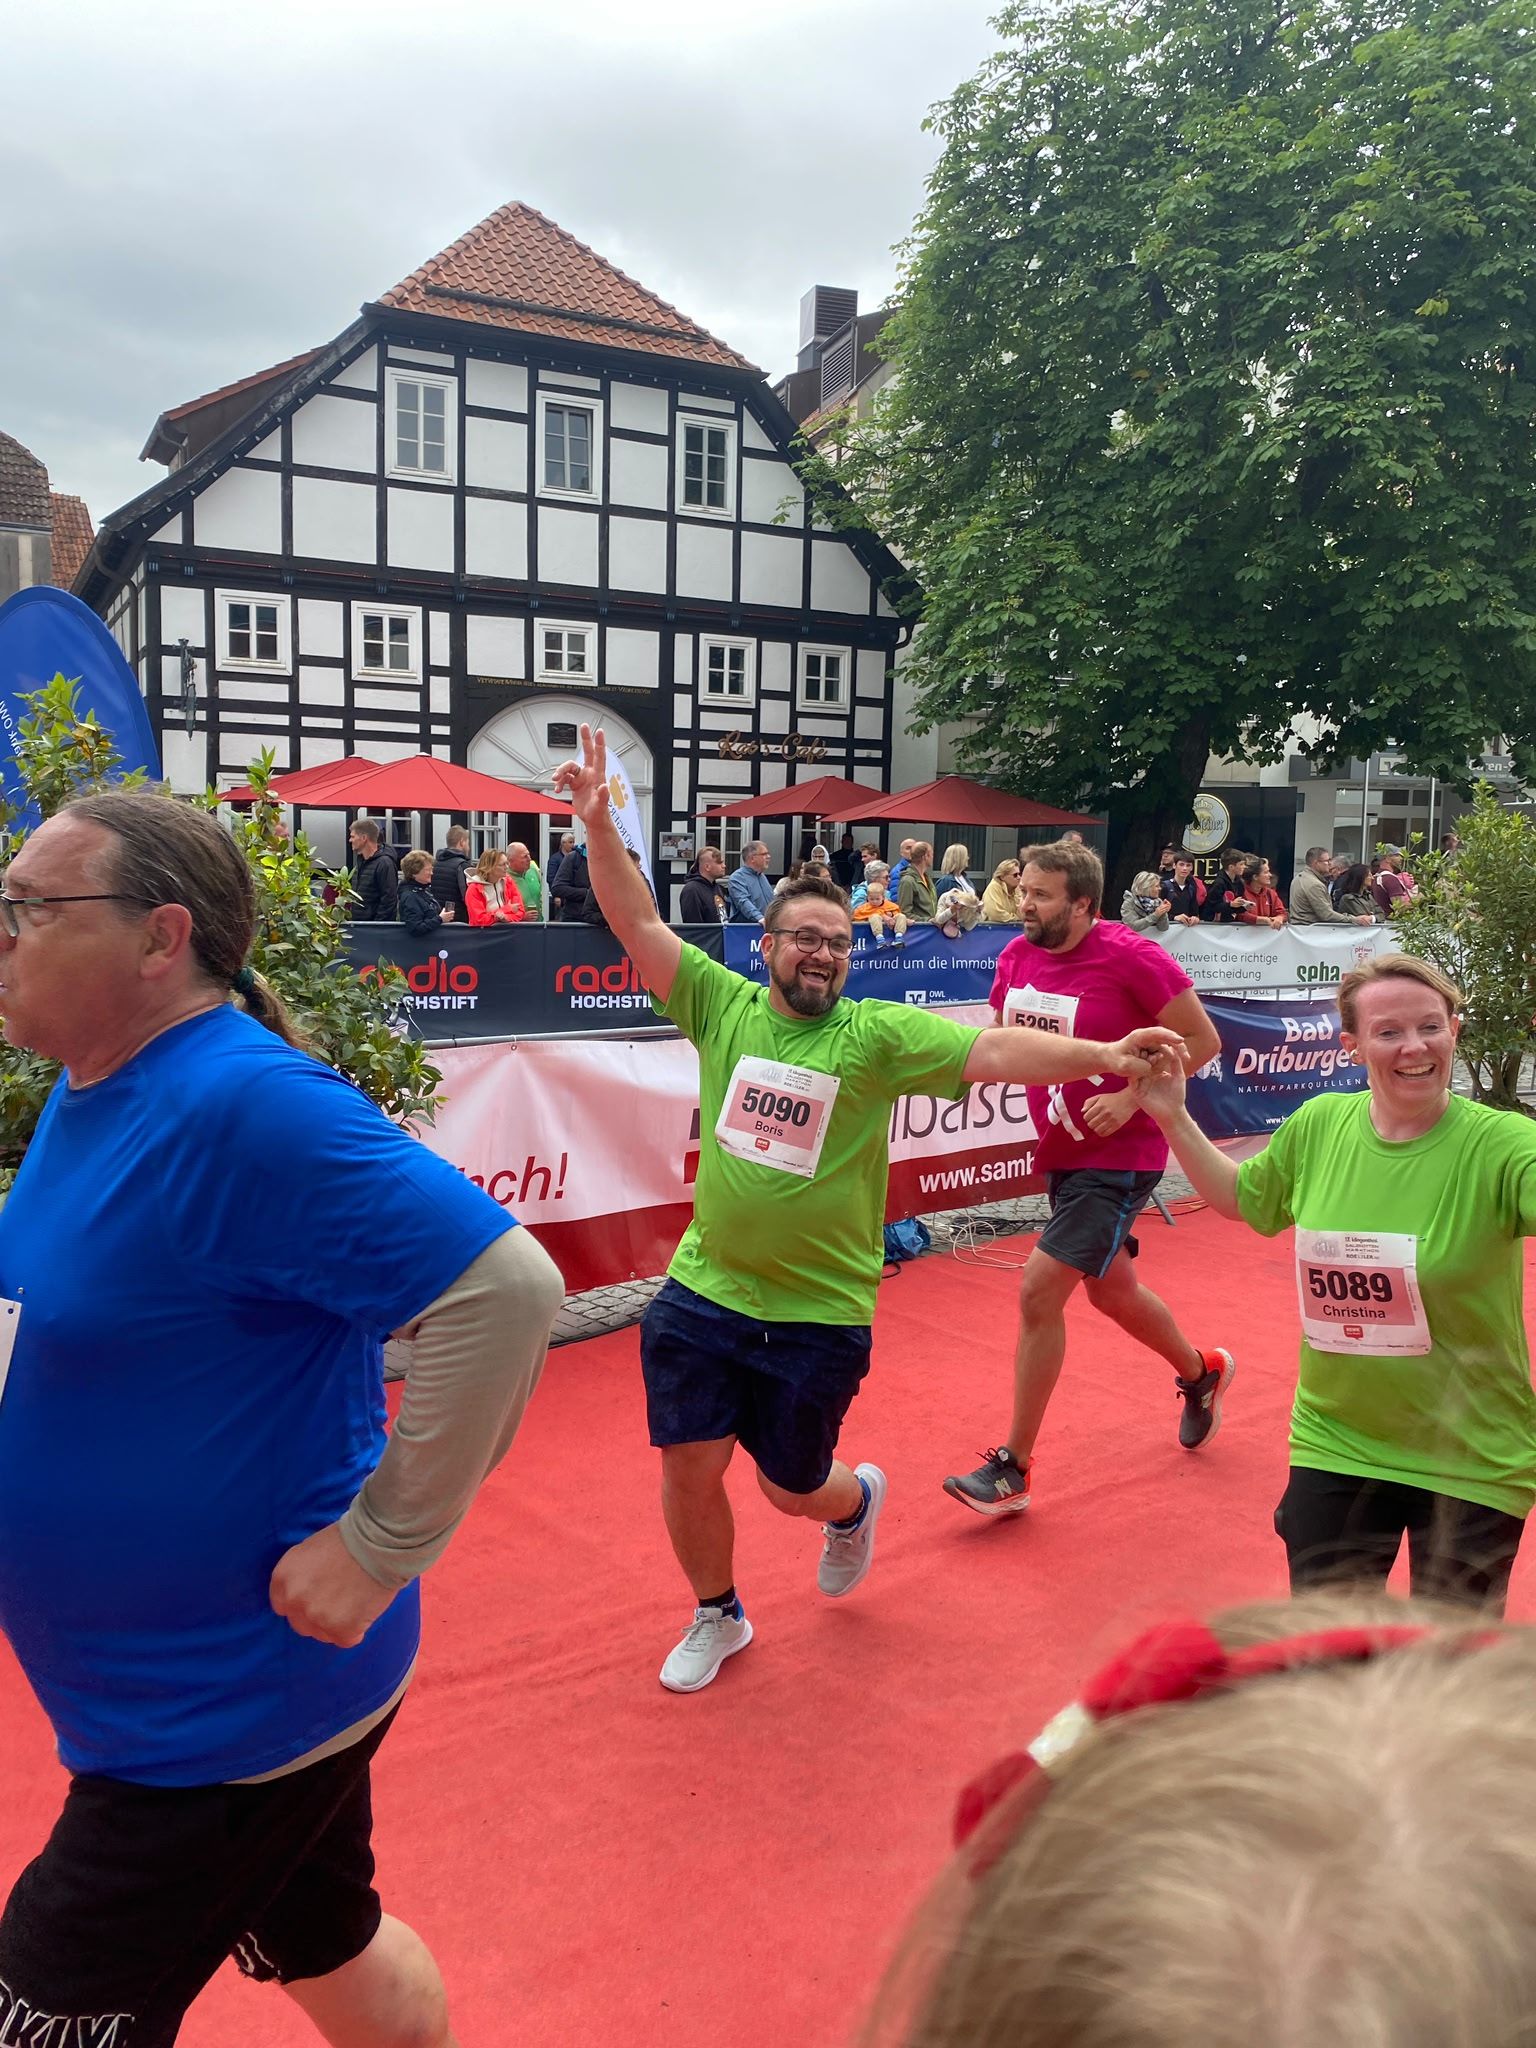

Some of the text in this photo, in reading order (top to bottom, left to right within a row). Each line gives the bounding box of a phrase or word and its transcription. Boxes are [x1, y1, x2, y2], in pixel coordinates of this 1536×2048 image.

[869, 957, 899, 969] rund
[903, 959, 924, 969] um
[928, 957, 947, 969] die
[1220, 952, 1238, 963] die
[1240, 952, 1278, 966] richtige
[555, 957, 650, 992] radi
[1186, 967, 1261, 981] Entscheidung
[1281, 1014, 1334, 1042] Bad
[1234, 1045, 1359, 1077] Driburge
[1238, 1078, 1361, 1093] NATURPARKQUELLEN
[741, 1087, 811, 1127] 5090
[755, 1120, 783, 1137] Boris
[1308, 1267, 1393, 1302] 5089
[1323, 1304, 1386, 1318] Christina
